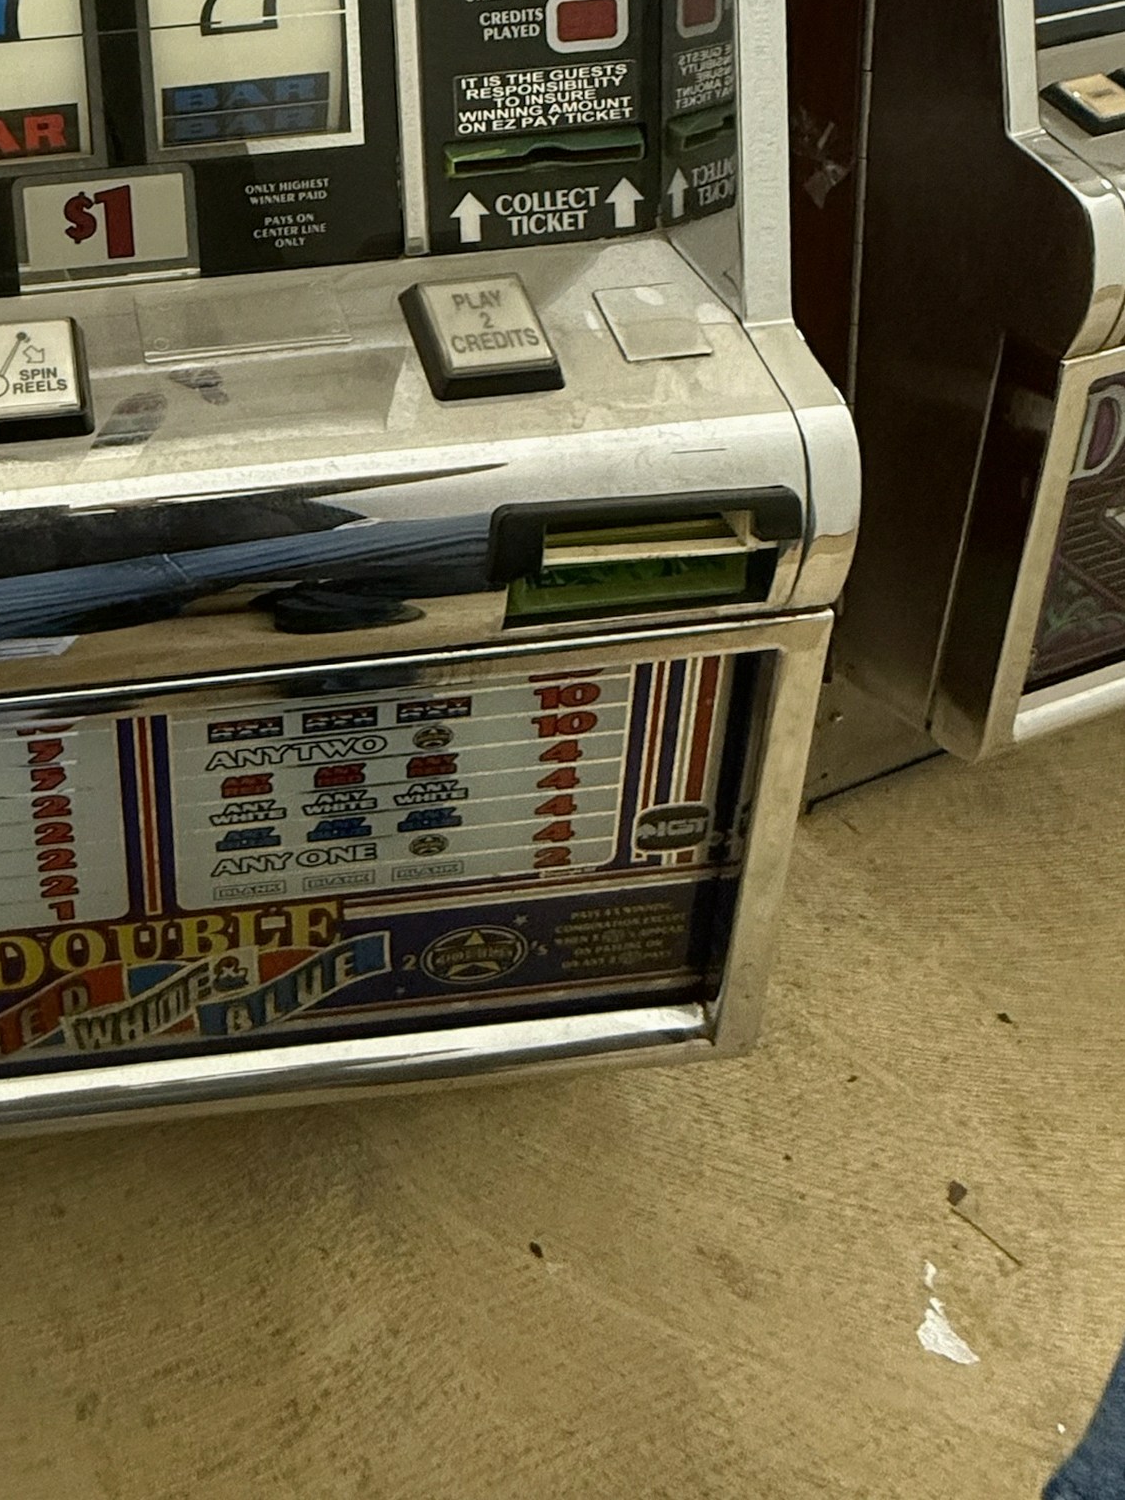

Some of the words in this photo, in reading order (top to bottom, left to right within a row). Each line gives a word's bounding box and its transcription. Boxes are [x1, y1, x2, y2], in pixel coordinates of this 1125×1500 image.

[479, 8, 543, 26] CREDITS
[484, 24, 540, 41] PLAYED
[461, 78, 477, 89] IT
[484, 76, 501, 87] IS
[506, 72, 543, 85] THE
[549, 64, 628, 81] GUESTS
[178, 73, 316, 111] BAR
[466, 76, 624, 100] RESPONSIBILITY
[493, 97, 519, 108] TO
[525, 89, 596, 106] INSURE
[459, 105, 543, 122] WINNING
[549, 96, 631, 114] AMOUNT
[458, 122, 486, 134] ON
[492, 119, 516, 131] EZ
[521, 115, 560, 128] PAY
[565, 107, 633, 124] TICKET
[245, 183, 276, 195] ONLY
[279, 178, 329, 191] HIGHEST
[249, 193, 295, 205] WINNER
[298, 190, 327, 200] PAID
[495, 186, 599, 216] COLLECT
[63, 184, 135, 259] $1
[253, 226, 299, 239] CENTER
[301, 222, 327, 234] LINE
[264, 215, 293, 226] PAYS
[296, 213, 315, 223] ON
[508, 210, 588, 236] TICKET
[275, 237, 306, 248] ONLY
[451, 289, 502, 311] PLAY
[479, 311, 494, 329] 2
[451, 327, 539, 353] CREDITS
[19, 367, 58, 381] SPIN
[12, 379, 68, 394] REELS
[533, 682, 601, 710] 10
[205, 745, 290, 772] ANY
[288, 735, 388, 760] TWO
[531, 711, 598, 738] 10
[211, 852, 293, 877] ANY
[296, 844, 377, 867] ONE
[532, 820, 575, 842] 4
[533, 846, 571, 868] 2
[40, 874, 79, 898] 2
[48, 900, 75, 921] 1
